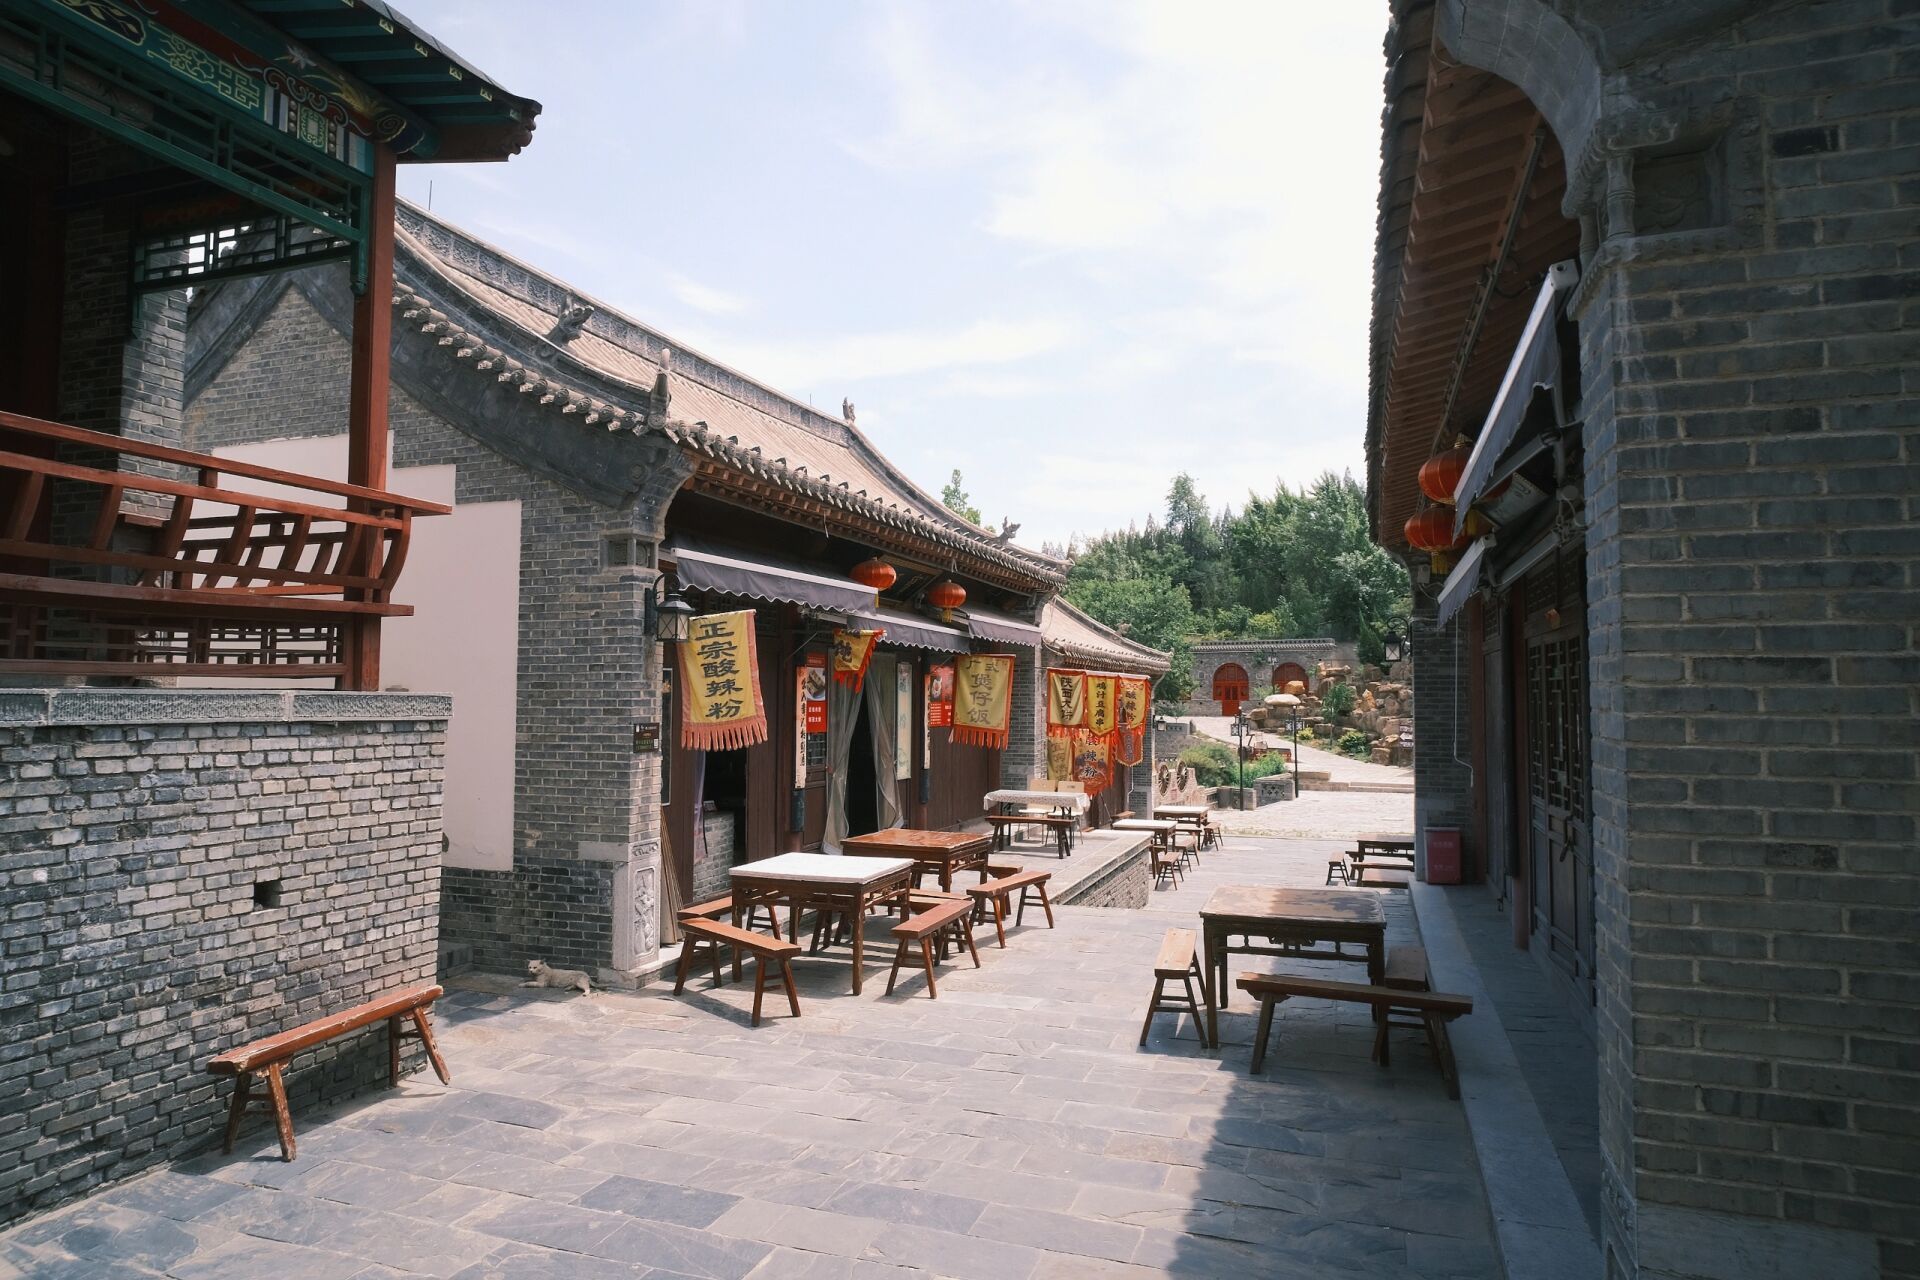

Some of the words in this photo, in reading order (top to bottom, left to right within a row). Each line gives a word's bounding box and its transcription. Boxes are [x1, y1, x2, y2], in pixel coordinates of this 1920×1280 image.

[695, 621, 744, 720] 正宗酸辣粉
[967, 673, 993, 725] 煲仔饭
